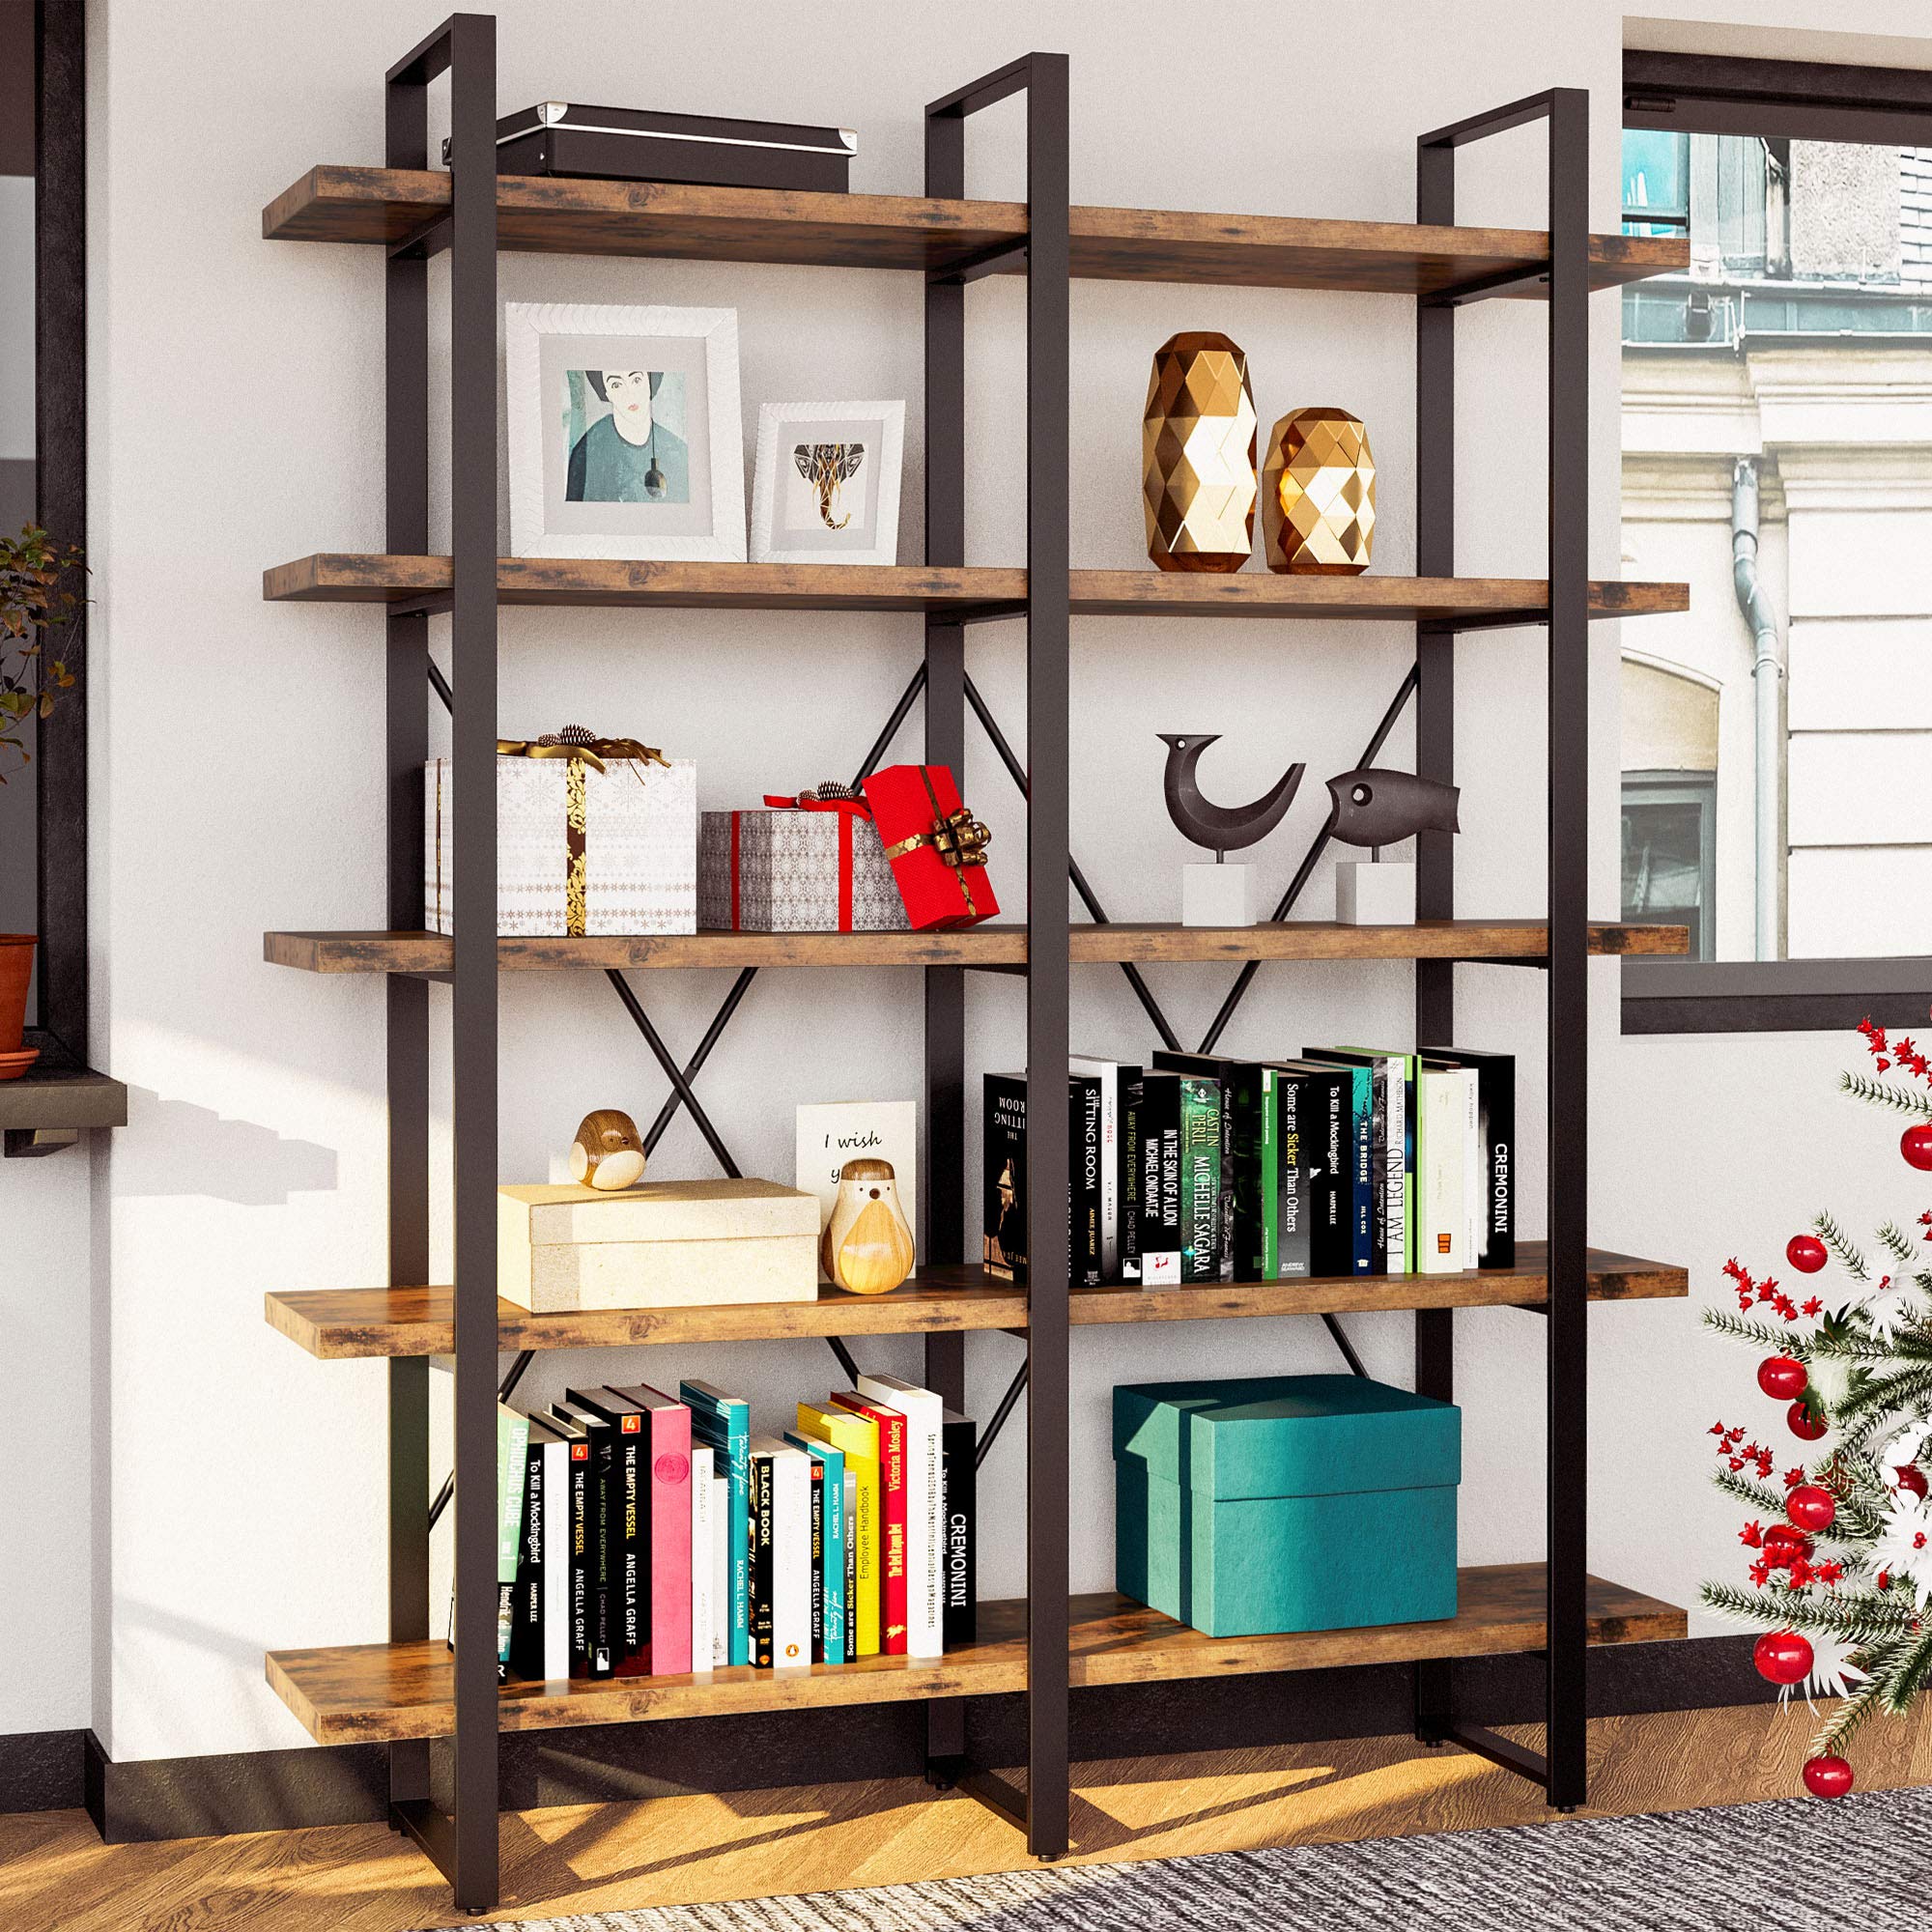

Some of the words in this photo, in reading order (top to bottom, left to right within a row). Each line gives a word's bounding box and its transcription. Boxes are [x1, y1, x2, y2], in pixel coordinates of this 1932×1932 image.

[999, 1097, 1026, 1114] ROOM
[1287, 1084, 1299, 1113] Some
[1329, 1086, 1340, 1097] To
[1329, 1099, 1340, 1113] Kill
[995, 1113, 1026, 1130] ITTING
[1086, 1089, 1096, 1143] SITTING
[1126, 1111, 1136, 1130] AWAY
[1192, 1115, 1207, 1146] PERIL
[1206, 1109, 1219, 1136] CAST
[1287, 1115, 1296, 1131] are
[825, 1134, 830, 1149] I
[838, 1130, 883, 1149] wish
[1007, 1130, 1018, 1141] THE
[1126, 1132, 1136, 1152] FROM
[1163, 1129, 1178, 1139] IN
[1206, 1137, 1219, 1147] IN
[1327, 1121, 1340, 1175] Mockingbird
[1146, 1138, 1158, 1175] MICHAEL
[1163, 1140, 1178, 1158] THE
[1287, 1132, 1299, 1166] Sicker
[1086, 1146, 1096, 1190] ROOM
[1126, 1153, 1136, 1202] EVERYWHERE
[1163, 1159, 1178, 1181] SKIN
[1287, 1167, 1299, 1195] Than
[1387, 1148, 1404, 1208] LEGEND
[1146, 1176, 1158, 1217] ONDAATJE
[1163, 1182, 1178, 1195] OF
[1194, 1155, 1210, 1220] MICHELLE
[1495, 1144, 1508, 1233] CREMONINI
[1126, 1211, 1136, 1230] CHAD
[1163, 1206, 1178, 1226] LION
[1287, 1196, 1299, 1233] Others
[1126, 1231, 1136, 1254] PELLEY
[1387, 1217, 1404, 1242] AM
[1194, 1223, 1210, 1273] SAGARA
[626, 1418, 636, 1431] 4
[889, 1420, 903, 1453] Mosley
[530, 1460, 541, 1472] To
[576, 1447, 584, 1458] 4
[626, 1445, 636, 1465] THE
[530, 1474, 541, 1491] Kill
[576, 1471, 584, 1490] THE
[626, 1467, 636, 1501] EMPTY
[760, 1465, 770, 1507] BLACK
[812, 1467, 819, 1478] 4
[889, 1455, 901, 1492] Victoria
[503, 1496, 523, 1528] CUBE
[576, 1492, 584, 1521] EMPTY
[626, 1502, 636, 1540] VESSEL
[860, 1486, 869, 1532] Handbook
[527, 1501, 541, 1563] Mockingbird
[576, 1522, 584, 1556] VESSEL
[760, 1510, 770, 1547] BOOK
[860, 1535, 869, 1579] Employee
[951, 1514, 967, 1607] CREMONINI
[576, 1569, 584, 1615] ANGELLA
[626, 1553, 636, 1605] ANGELLA
[736, 1560, 745, 1595] RACHEL
[498, 1586, 513, 1616] Hendrik
[736, 1602, 745, 1629] HAMM
[497, 1620, 512, 1630] de
[576, 1618, 584, 1651] GRAFF
[626, 1608, 636, 1645] GRAFF
